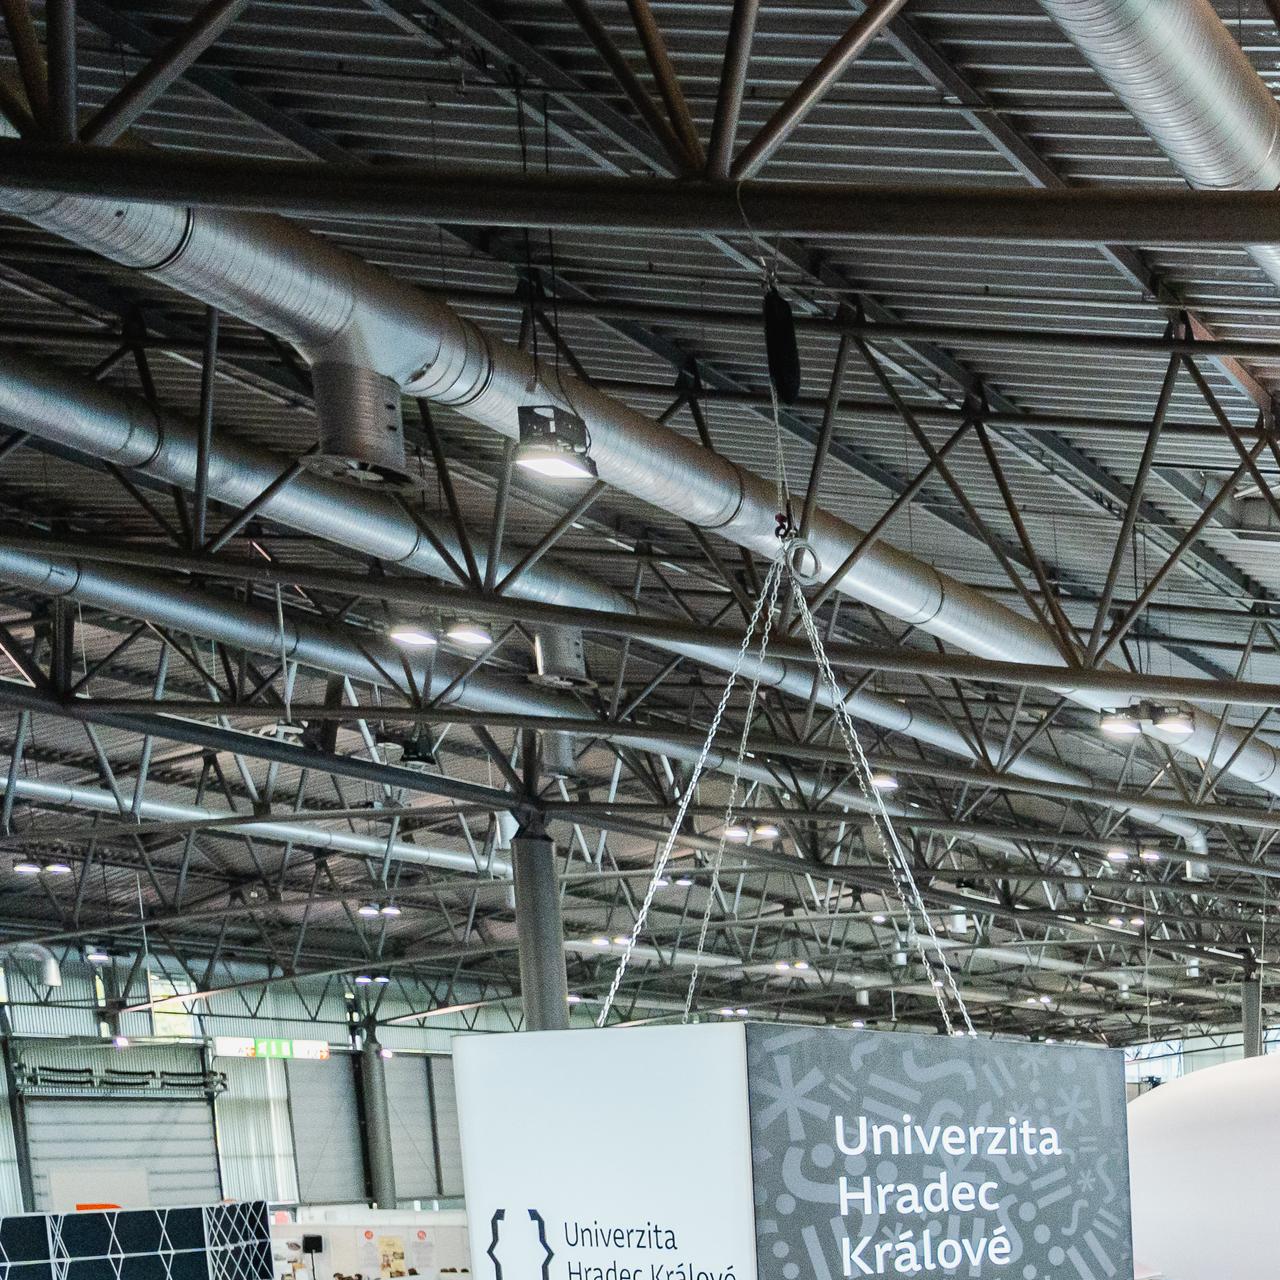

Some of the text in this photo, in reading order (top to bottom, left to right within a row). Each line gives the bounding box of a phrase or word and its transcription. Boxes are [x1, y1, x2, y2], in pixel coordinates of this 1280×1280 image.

[834, 1114, 1062, 1156] Univerzita
[838, 1174, 1000, 1215] Hradec
[563, 1220, 678, 1251] Univerzita
[841, 1226, 1011, 1276] Králové
